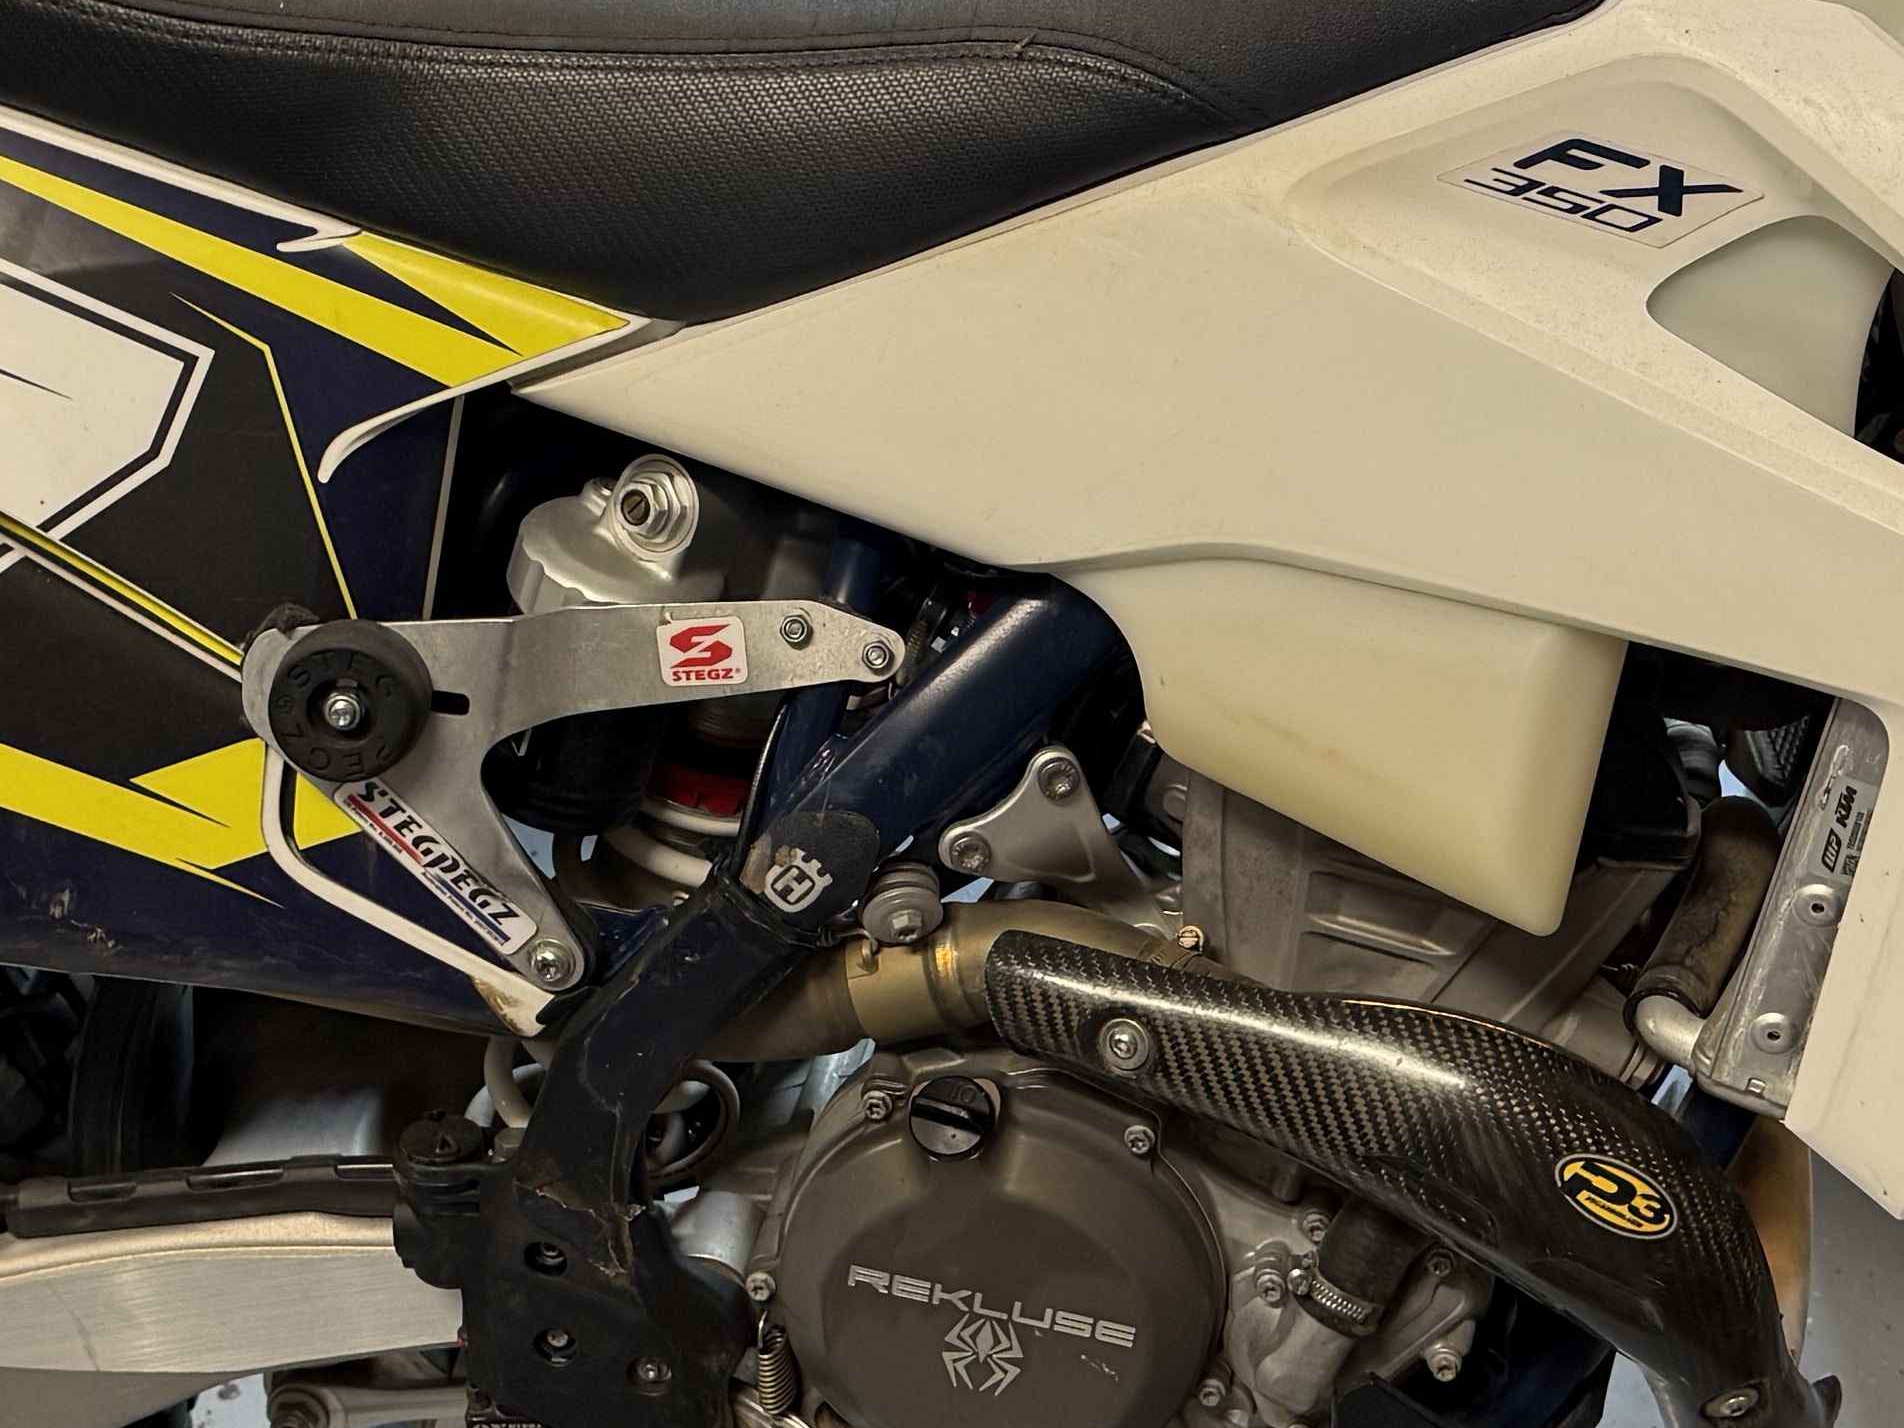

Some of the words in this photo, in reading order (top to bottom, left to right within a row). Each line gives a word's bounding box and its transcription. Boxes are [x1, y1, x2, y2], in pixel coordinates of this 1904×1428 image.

[1464, 167, 1661, 233] 350
[1513, 137, 1743, 218] FX
[672, 668, 733, 681] STEGZ
[1831, 783, 1857, 828] KTM
[847, 1265, 1136, 1349] REKLUSE
